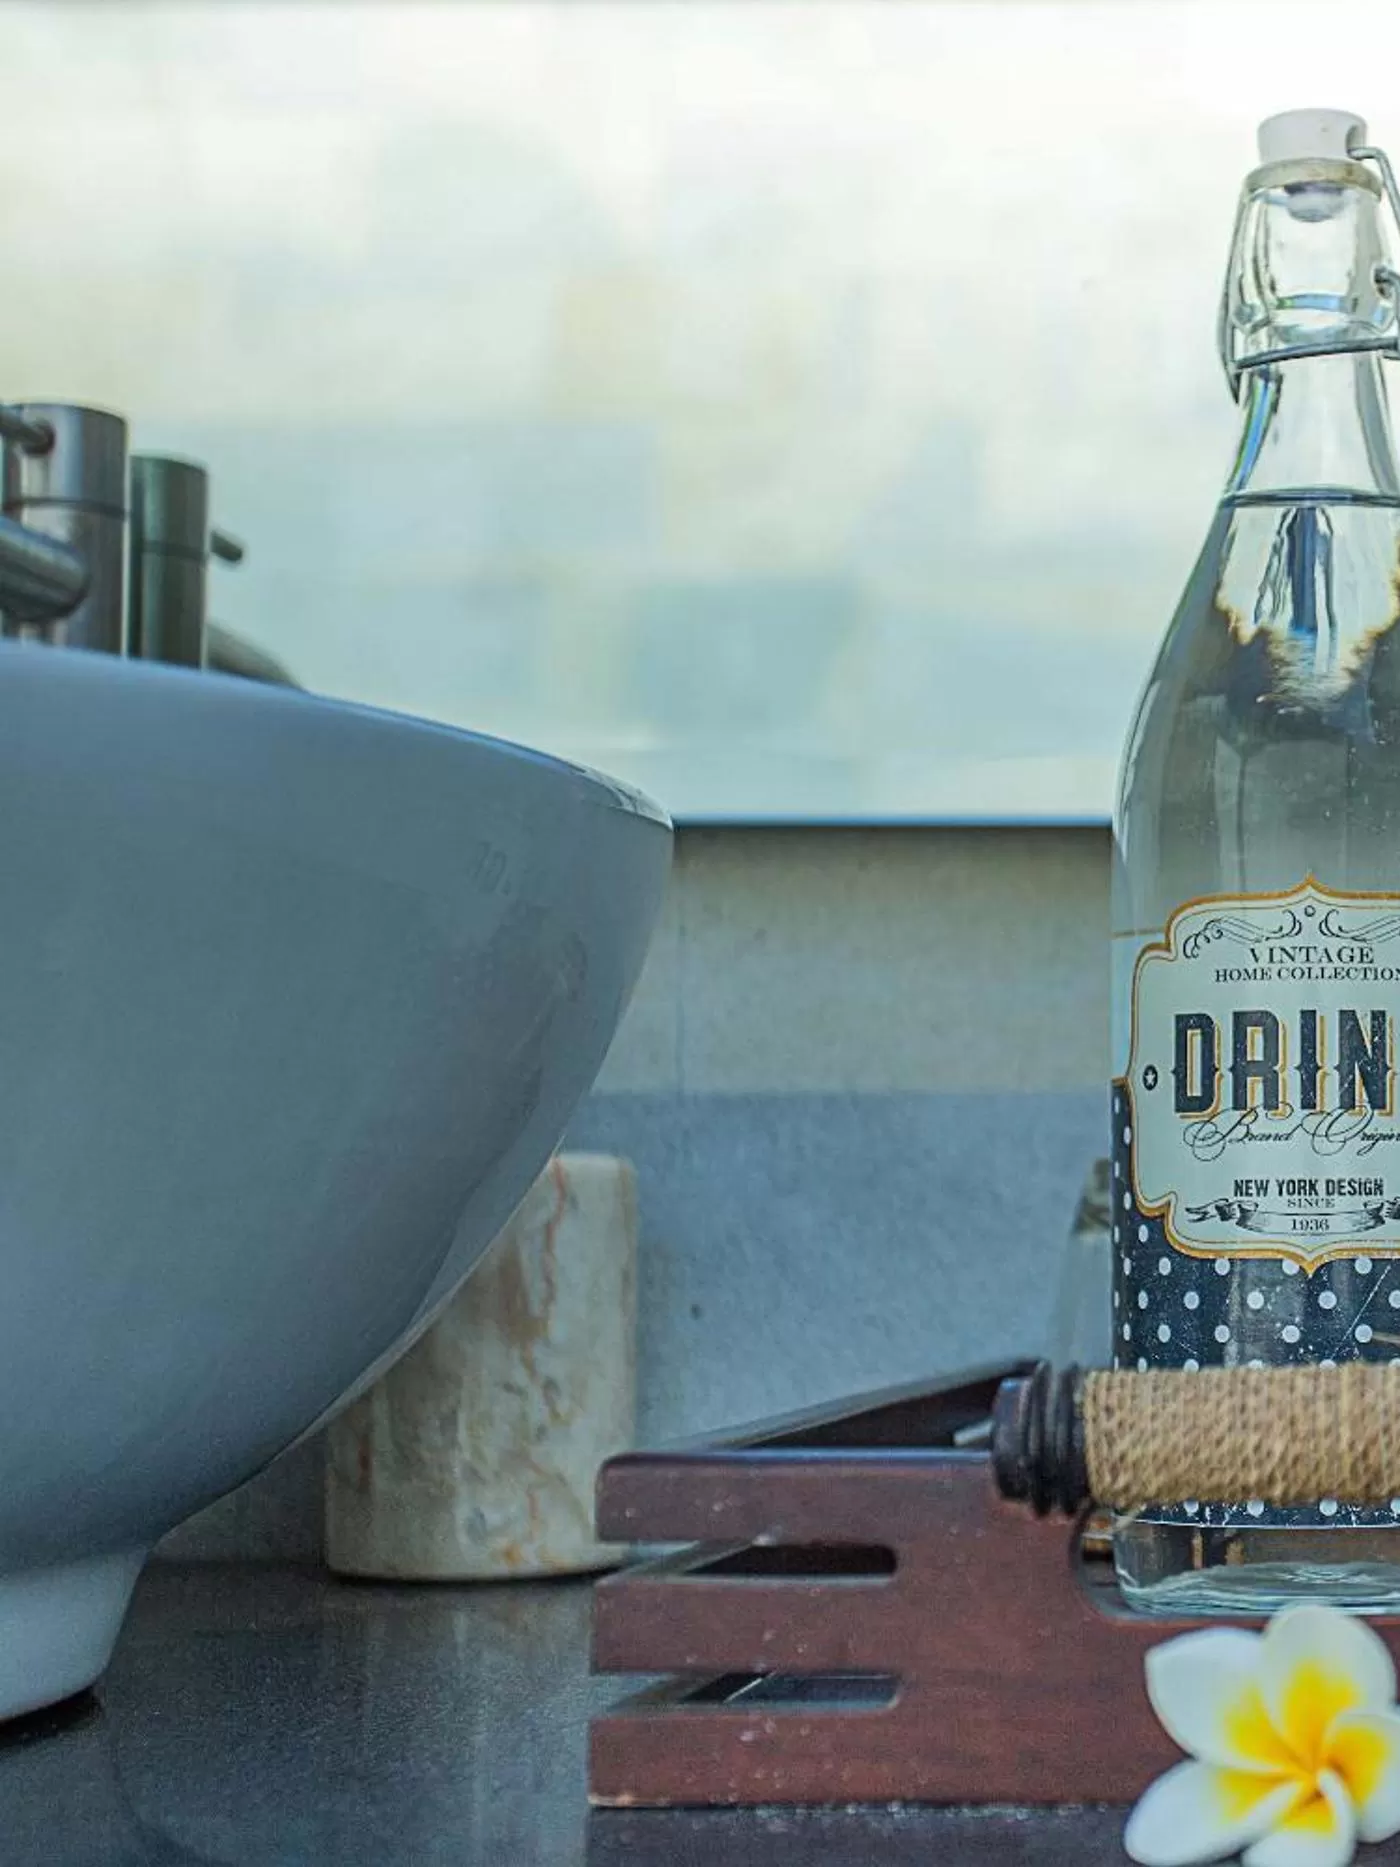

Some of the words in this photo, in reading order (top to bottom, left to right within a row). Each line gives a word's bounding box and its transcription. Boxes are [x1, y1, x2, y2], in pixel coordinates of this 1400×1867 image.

[1249, 945, 1375, 965] VINTAGE
[1214, 967, 1272, 983] HOME
[1183, 1101, 1300, 1161] Brand
[1233, 1178, 1270, 1197] NEW
[1274, 1178, 1319, 1197] YORK
[1325, 1177, 1384, 1197] DESIGN
[1287, 1198, 1336, 1209] SINCE
[1290, 1217, 1331, 1231] 1936
